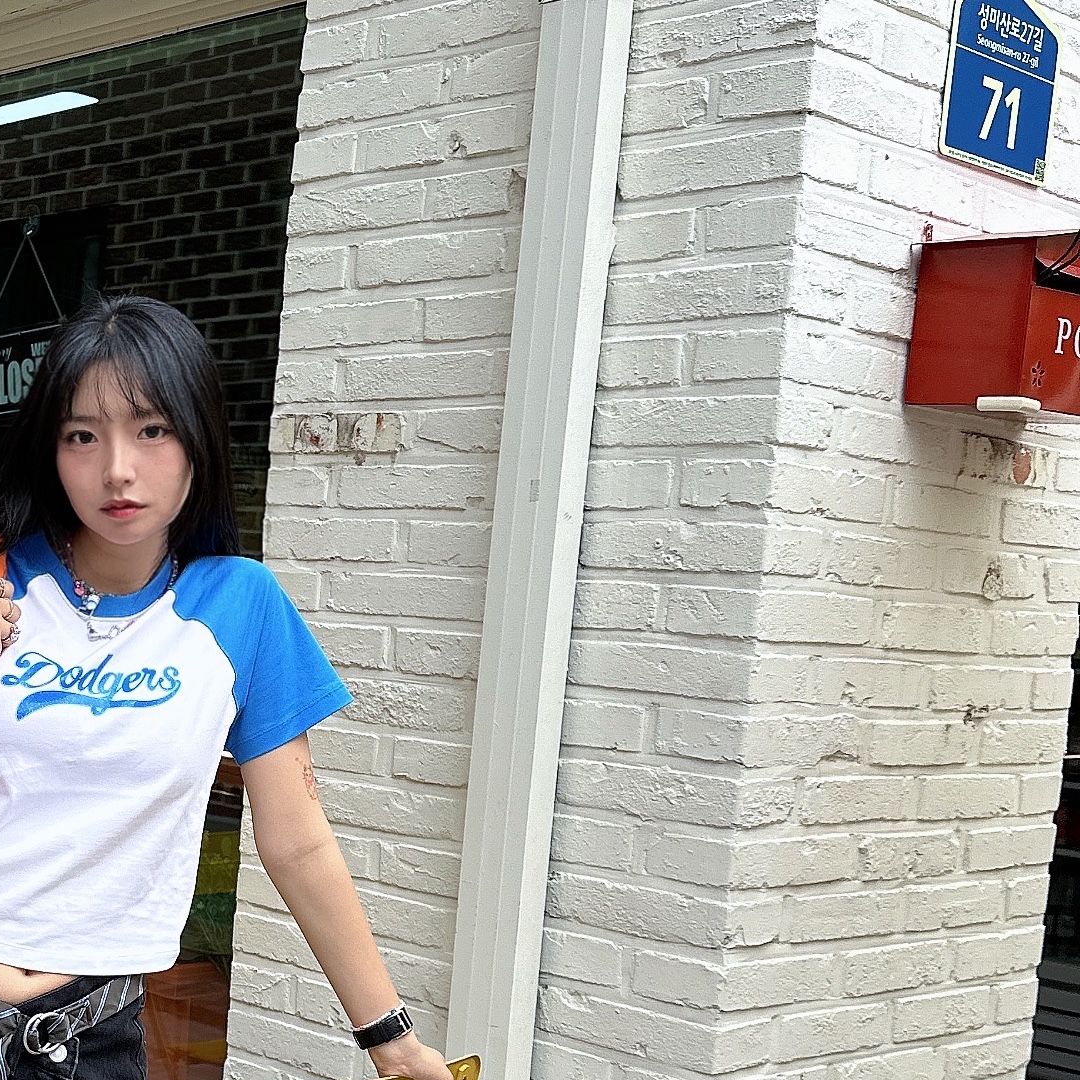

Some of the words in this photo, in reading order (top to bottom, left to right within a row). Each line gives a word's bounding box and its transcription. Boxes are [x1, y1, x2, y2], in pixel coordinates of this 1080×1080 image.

[976, 33, 1022, 61] Seongmisan-ro
[1021, 51, 1040, 69] 27-gil
[977, 3, 1045, 53] 성미산로27길
[978, 75, 1022, 150] 71
[1054, 316, 1080, 359] P
[0, 650, 182, 717] Dodgers
